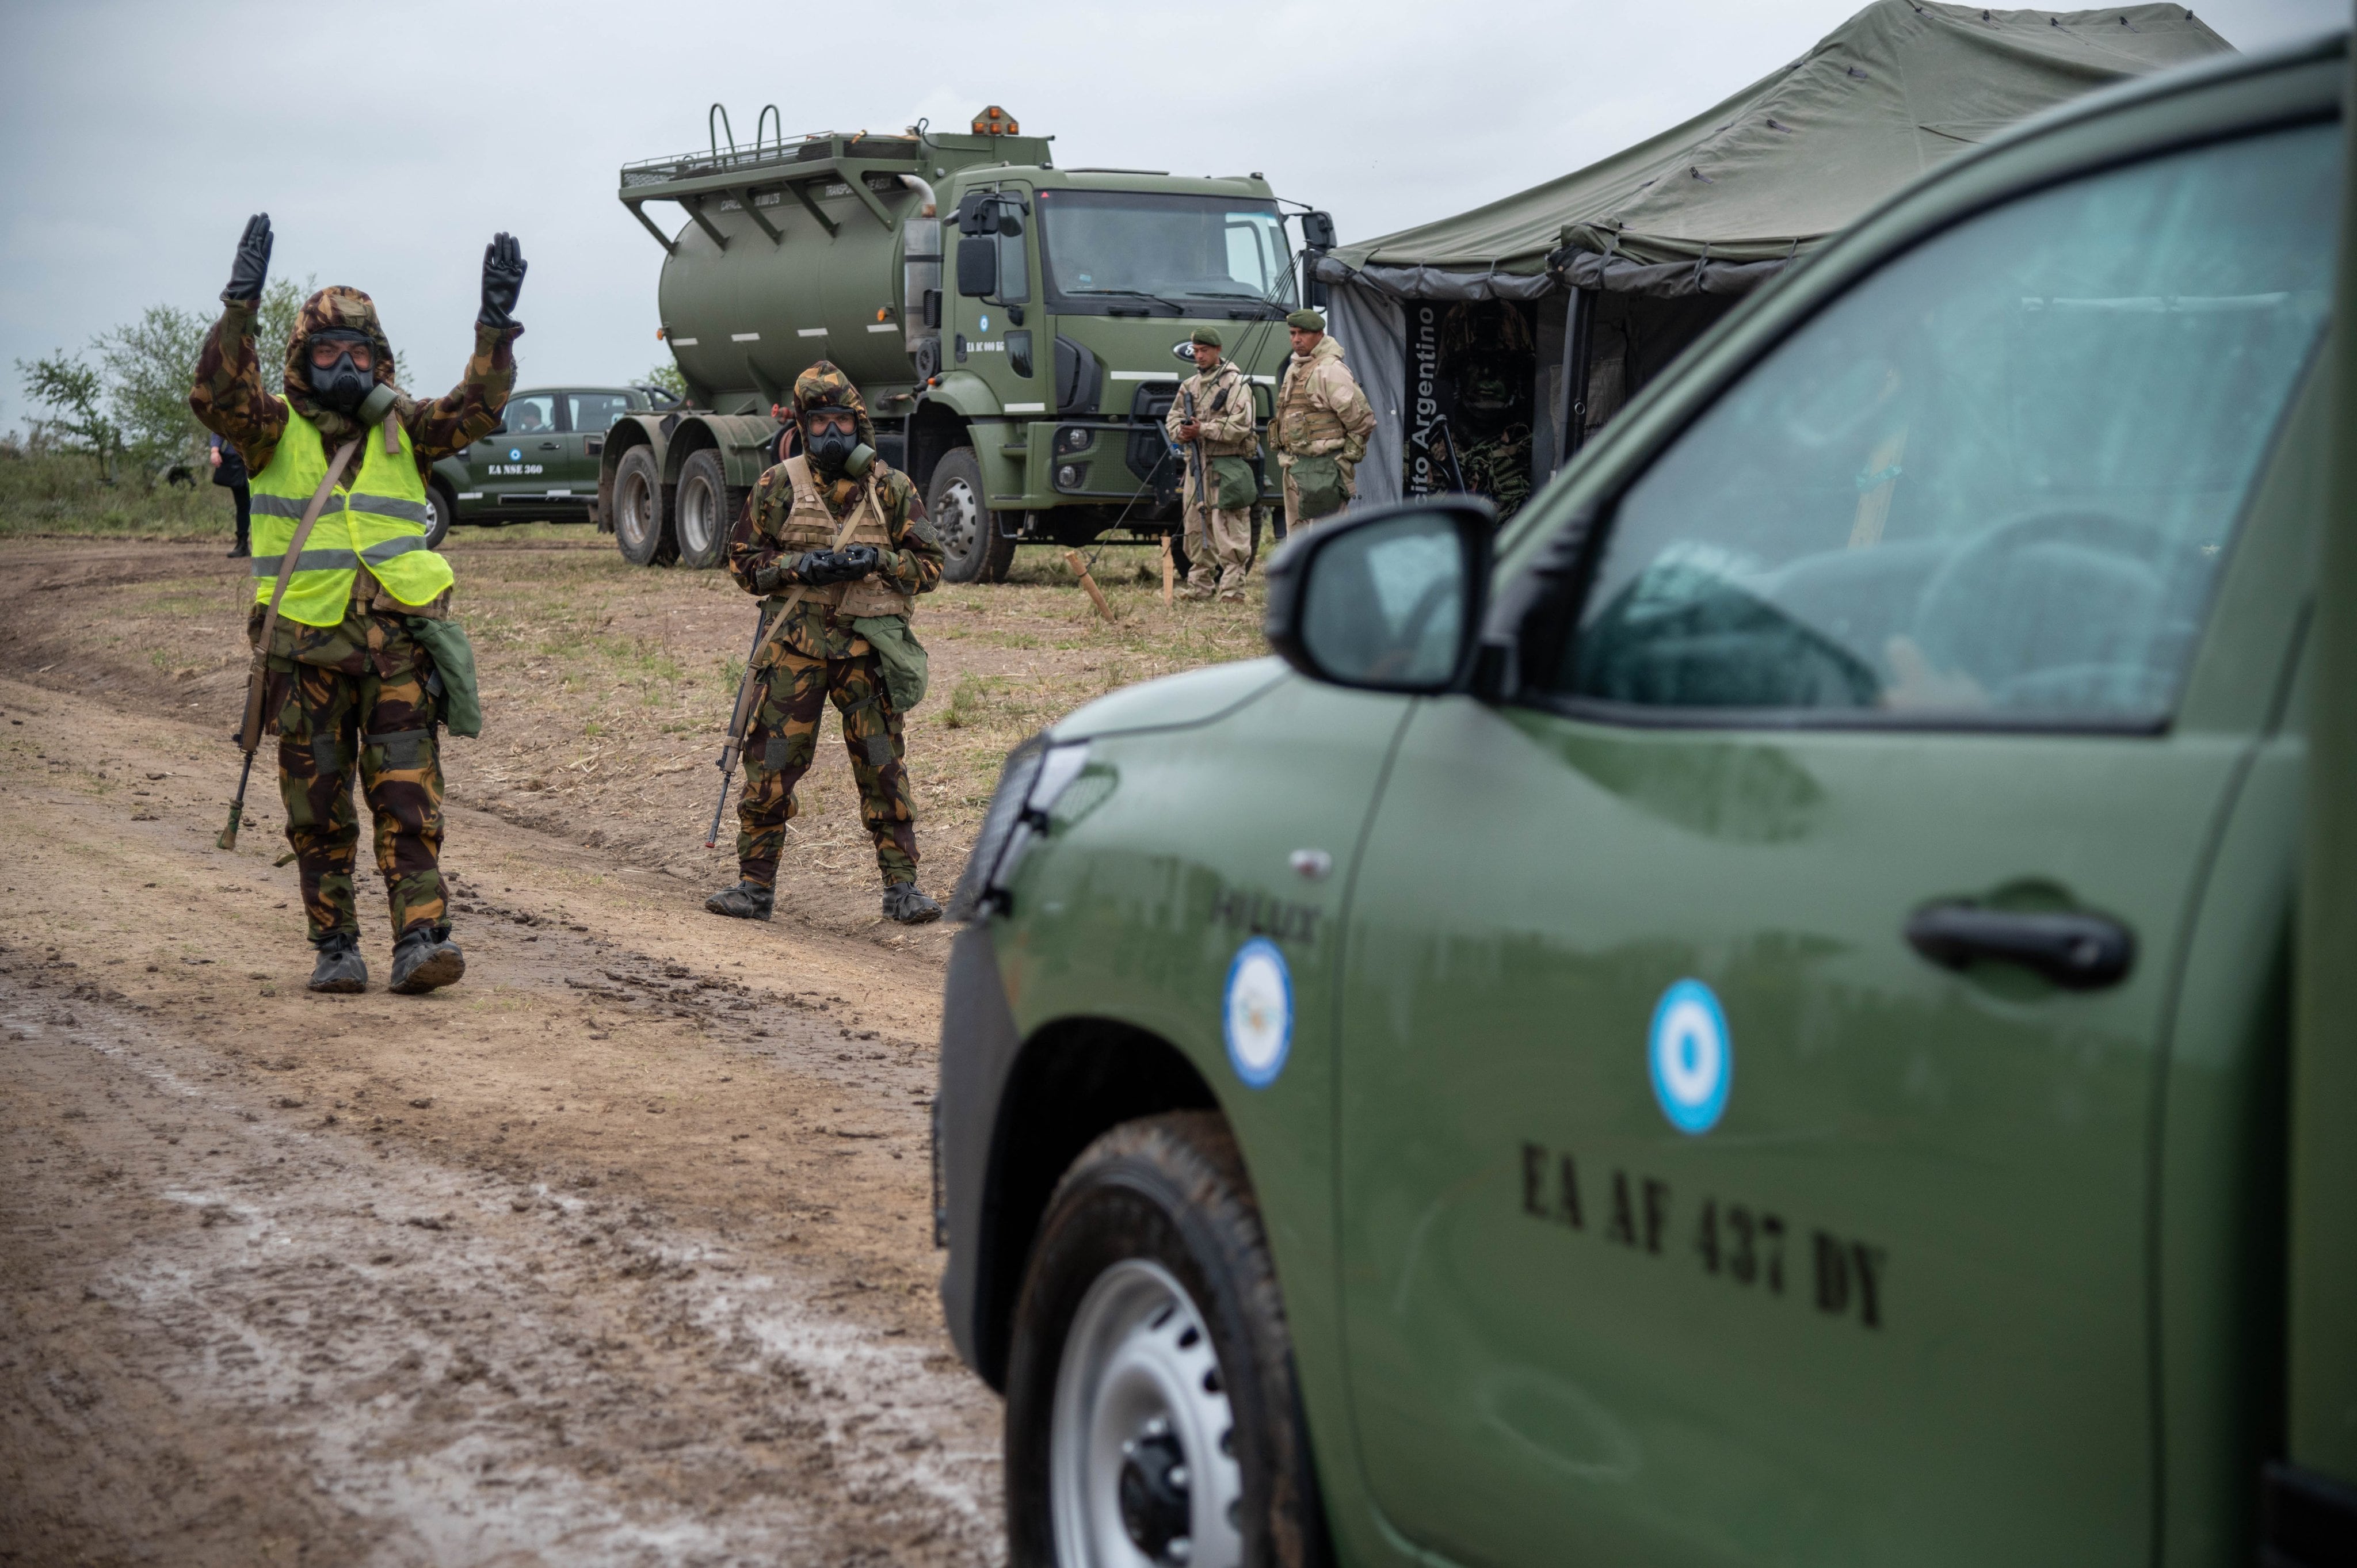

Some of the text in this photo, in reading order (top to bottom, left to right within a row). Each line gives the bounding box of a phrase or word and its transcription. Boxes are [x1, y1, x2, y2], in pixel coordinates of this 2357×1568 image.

[489, 464, 543, 475] EA NSE 360
[1411, 307, 1437, 505] cito Argentino
[1520, 1140, 1888, 1330] EA AF 437 DY
